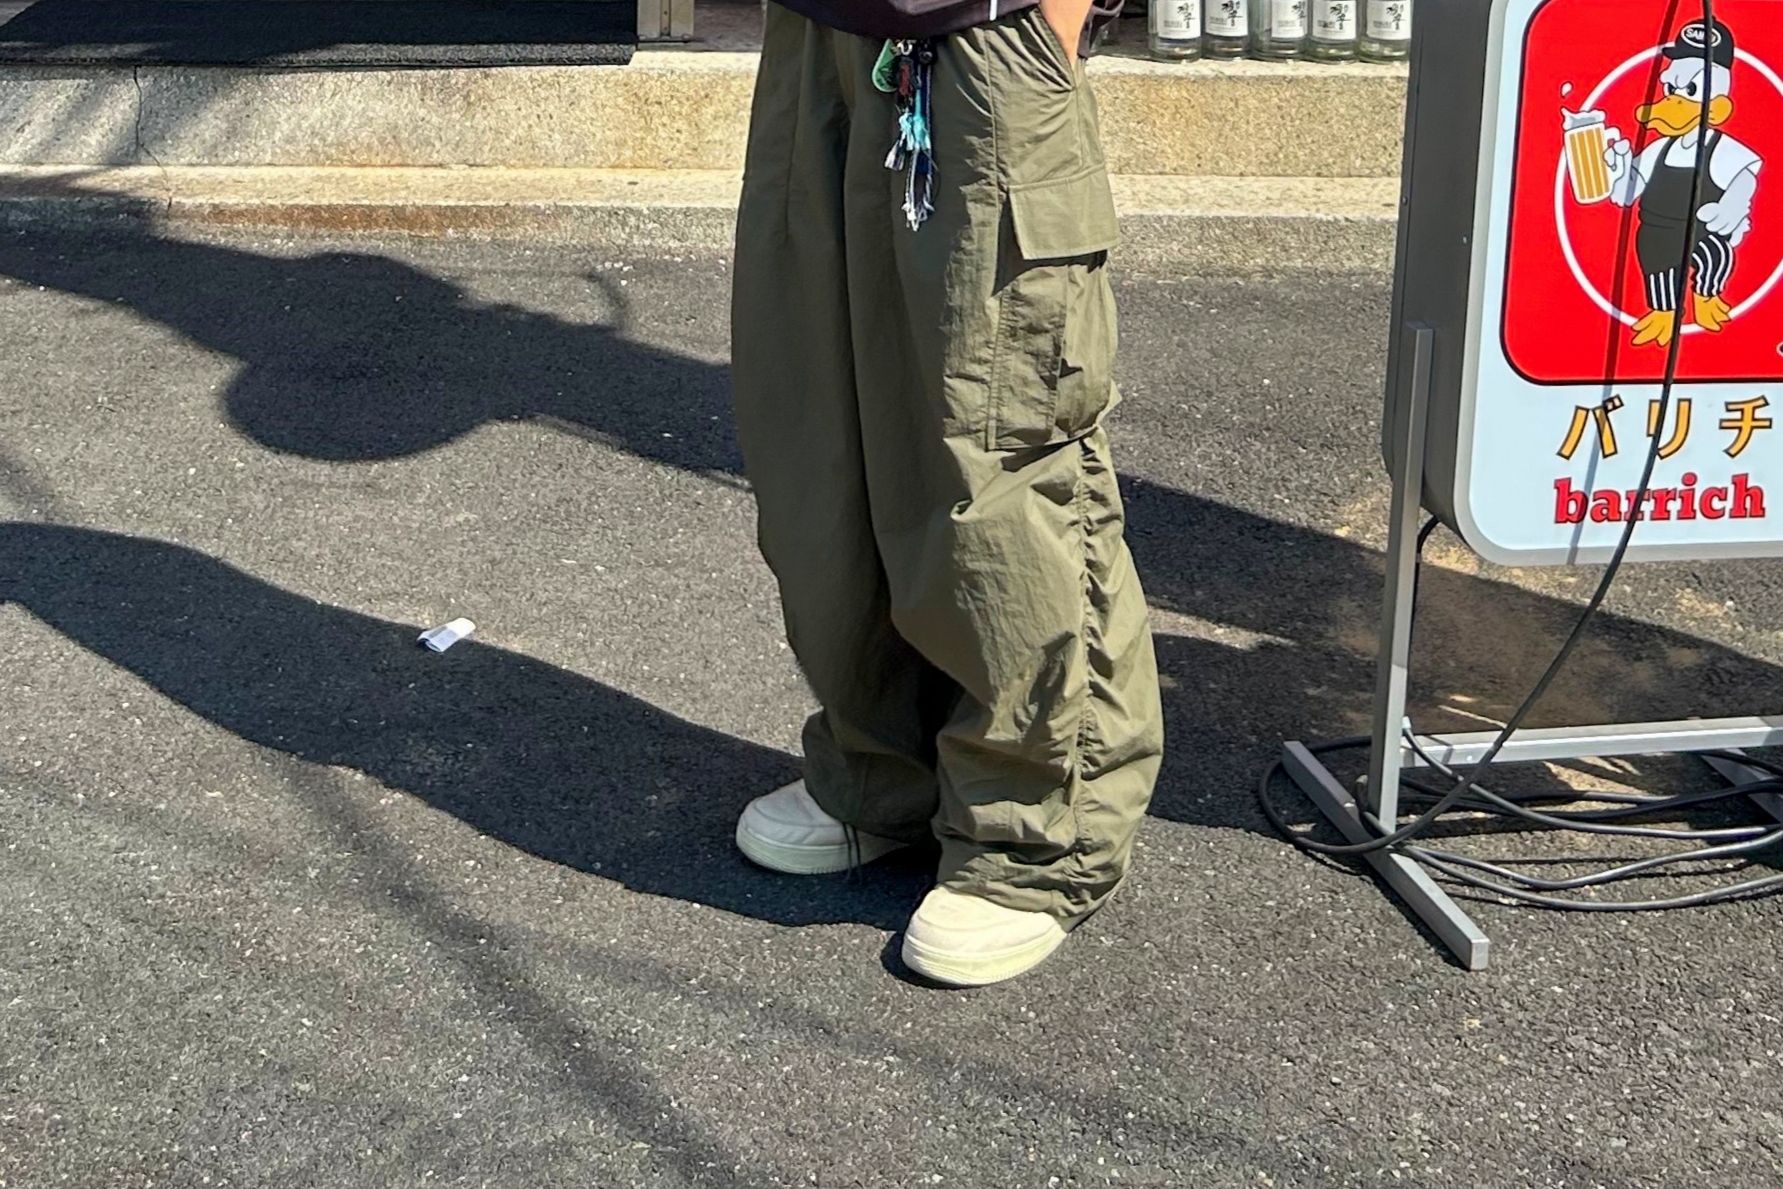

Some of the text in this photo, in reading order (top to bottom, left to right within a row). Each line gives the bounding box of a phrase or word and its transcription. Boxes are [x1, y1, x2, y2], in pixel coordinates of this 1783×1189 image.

[1556, 393, 1773, 461] バリチ
[1554, 471, 1767, 524] barrich
